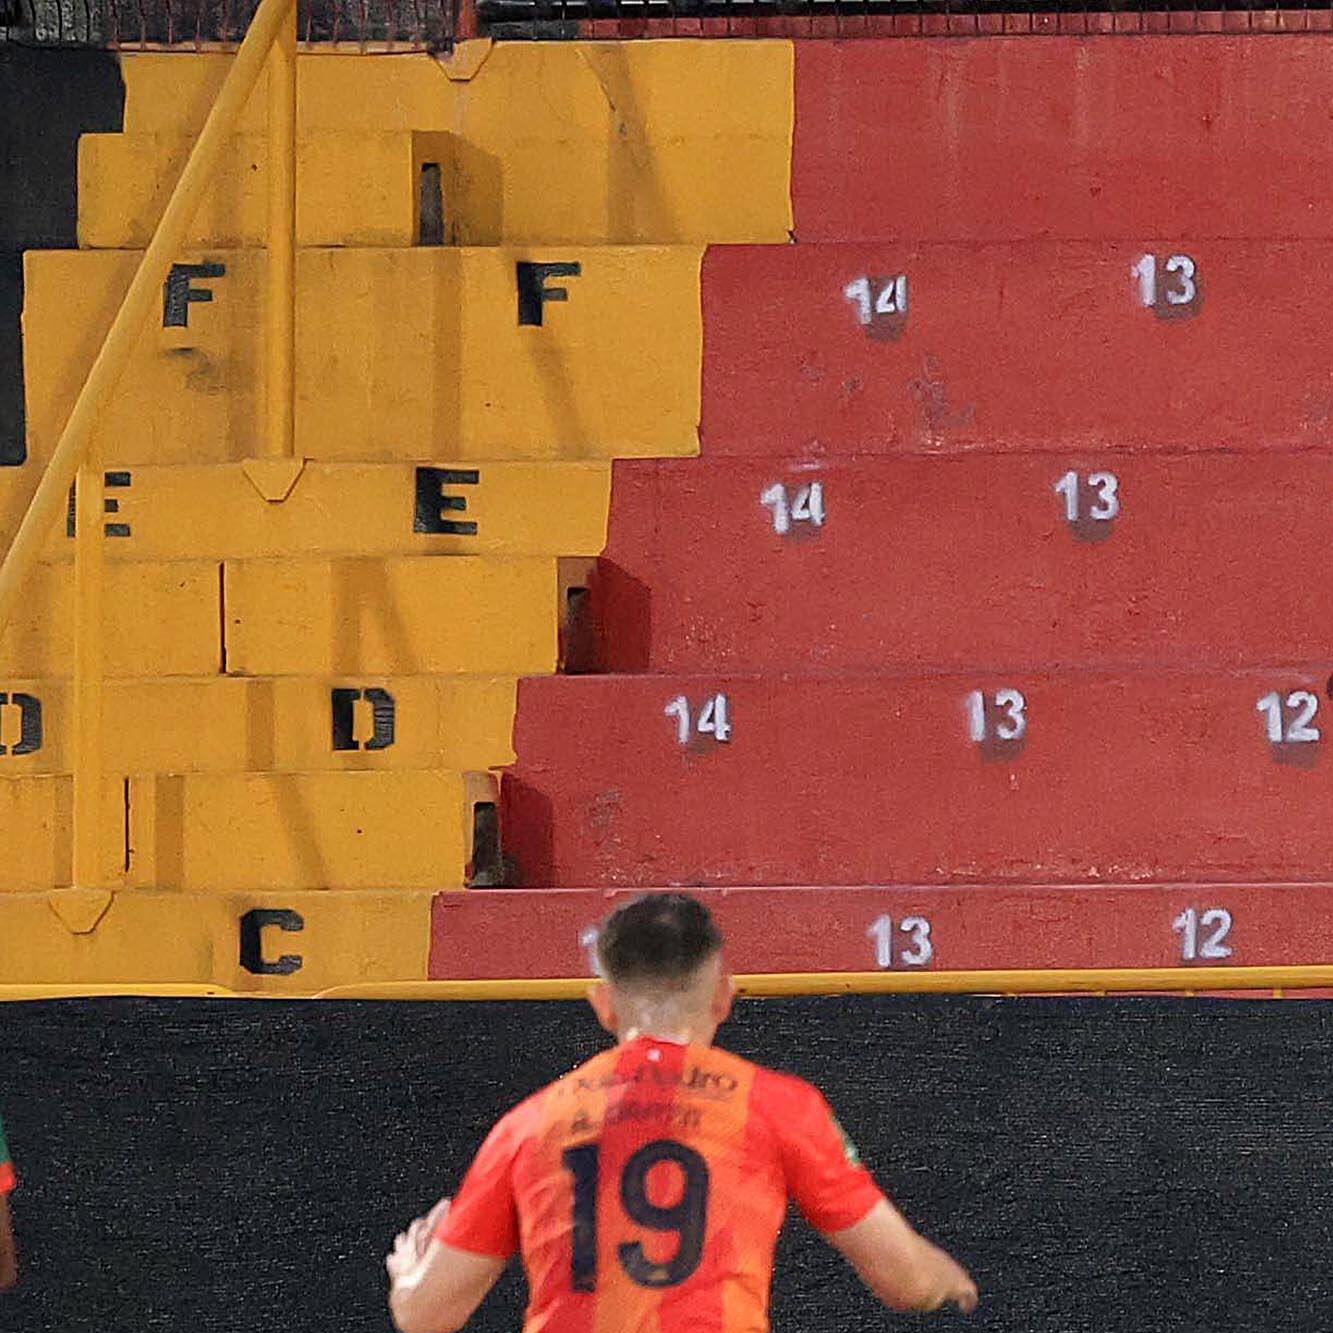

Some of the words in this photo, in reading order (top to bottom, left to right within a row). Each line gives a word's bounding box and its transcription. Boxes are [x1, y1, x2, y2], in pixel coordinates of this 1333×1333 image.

[163, 262, 225, 327] F
[517, 261, 580, 326] F
[844, 275, 908, 324] 14
[1131, 255, 1197, 305] 13
[413, 467, 479, 535] E
[761, 482, 825, 533] 14
[1056, 471, 1120, 520] 13
[332, 688, 395, 751] D
[666, 693, 732, 744] 14
[965, 689, 1027, 742] 13
[1257, 690, 1320, 742] 12
[239, 909, 304, 975] C
[867, 914, 933, 968] 13
[1173, 909, 1233, 961] 12
[562, 1139, 710, 1293] 19
